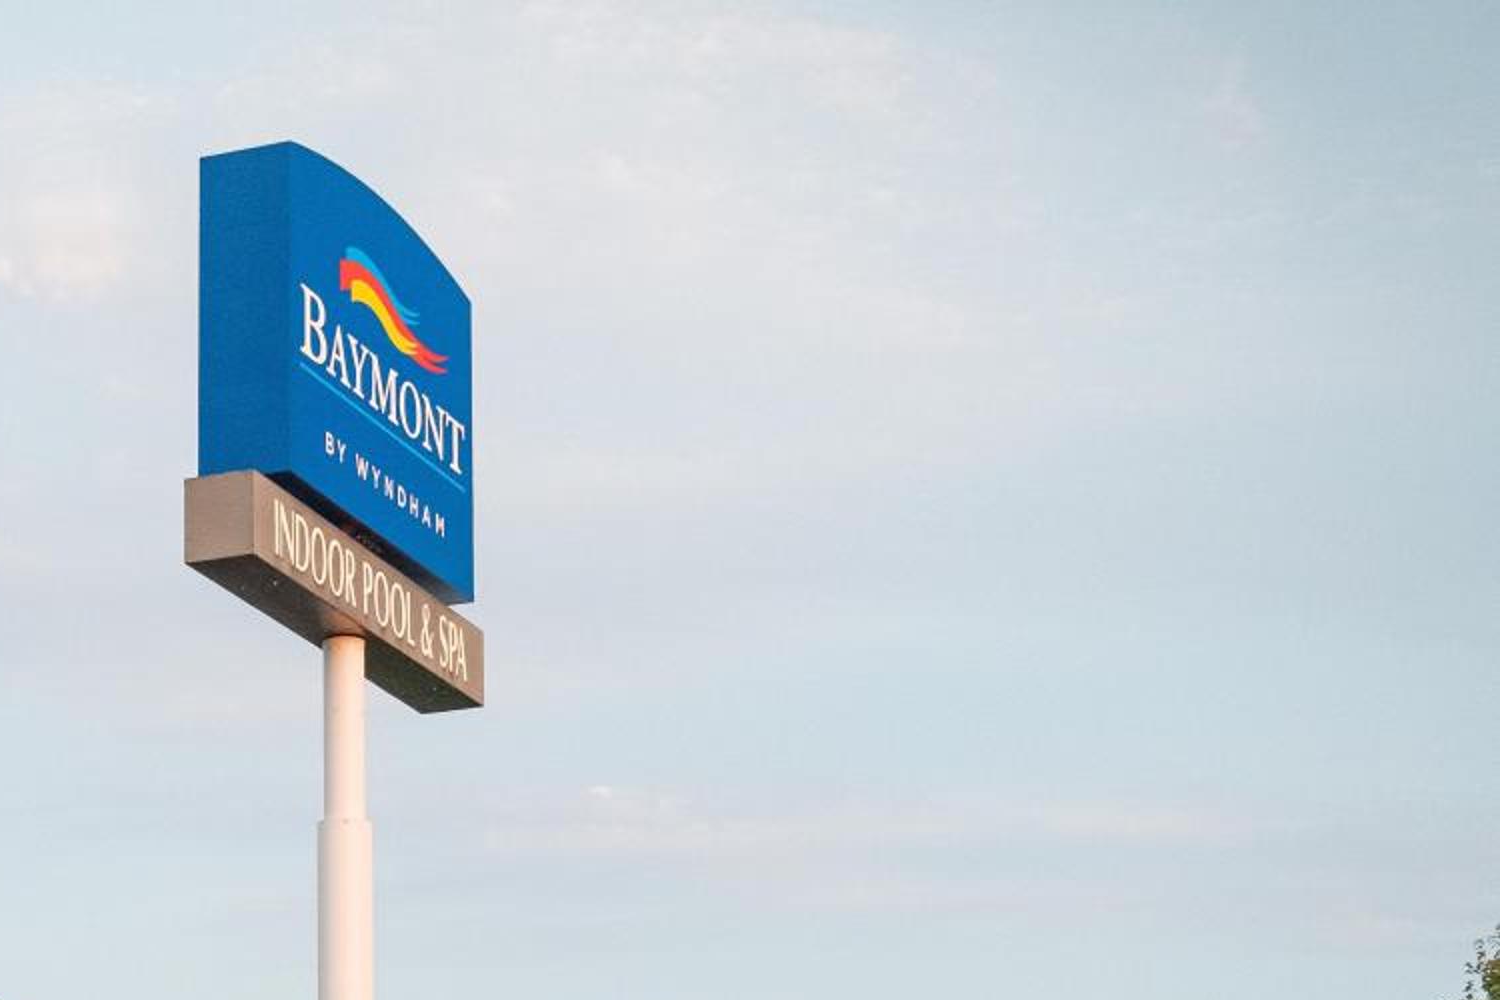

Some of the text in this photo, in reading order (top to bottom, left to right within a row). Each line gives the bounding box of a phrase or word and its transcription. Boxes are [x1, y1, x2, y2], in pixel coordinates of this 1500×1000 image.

[300, 283, 465, 474] BAYMONT
[324, 431, 446, 538] BY WYNDHAM
[274, 499, 469, 682] INDOOR POOL & SPA
